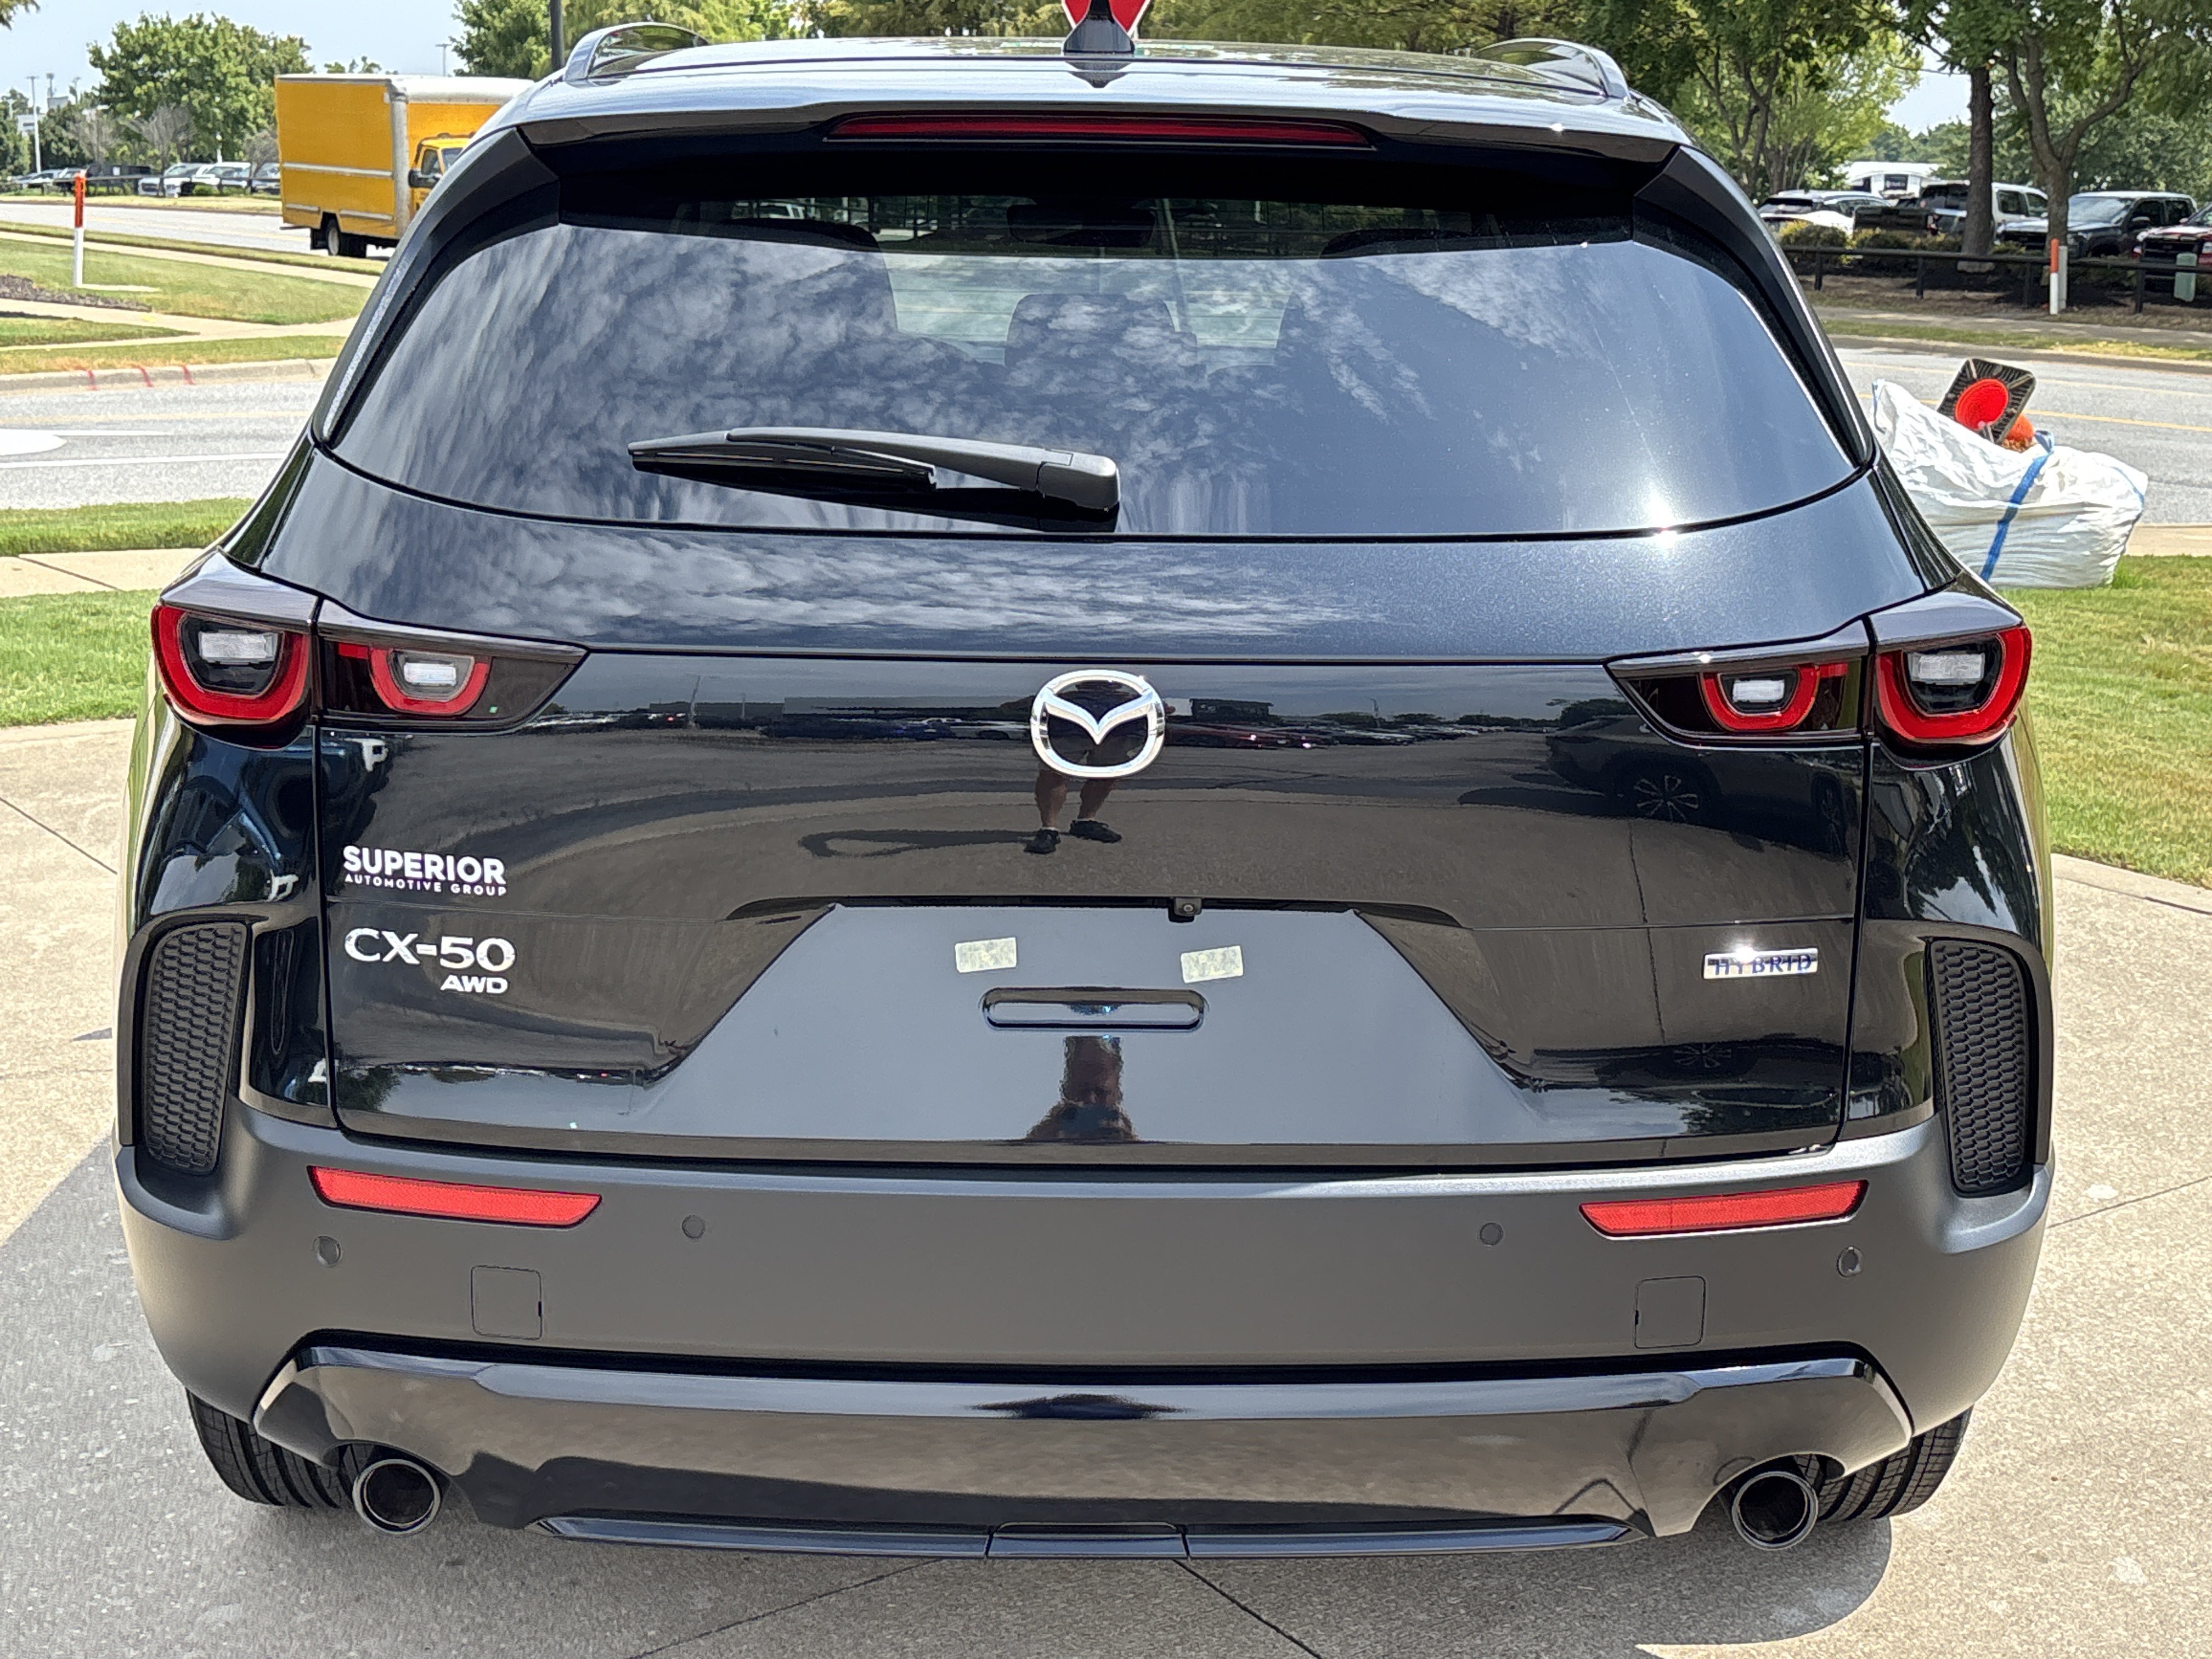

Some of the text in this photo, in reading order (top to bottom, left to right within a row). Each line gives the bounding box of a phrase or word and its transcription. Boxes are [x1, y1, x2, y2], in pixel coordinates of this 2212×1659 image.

[343, 845, 506, 885] SUPERIOR
[345, 873, 507, 896] AUTOMOTIVE GROUP
[345, 928, 516, 972] CX-50
[1715, 953, 1812, 975] HYBRID
[440, 974, 508, 994] AWD
